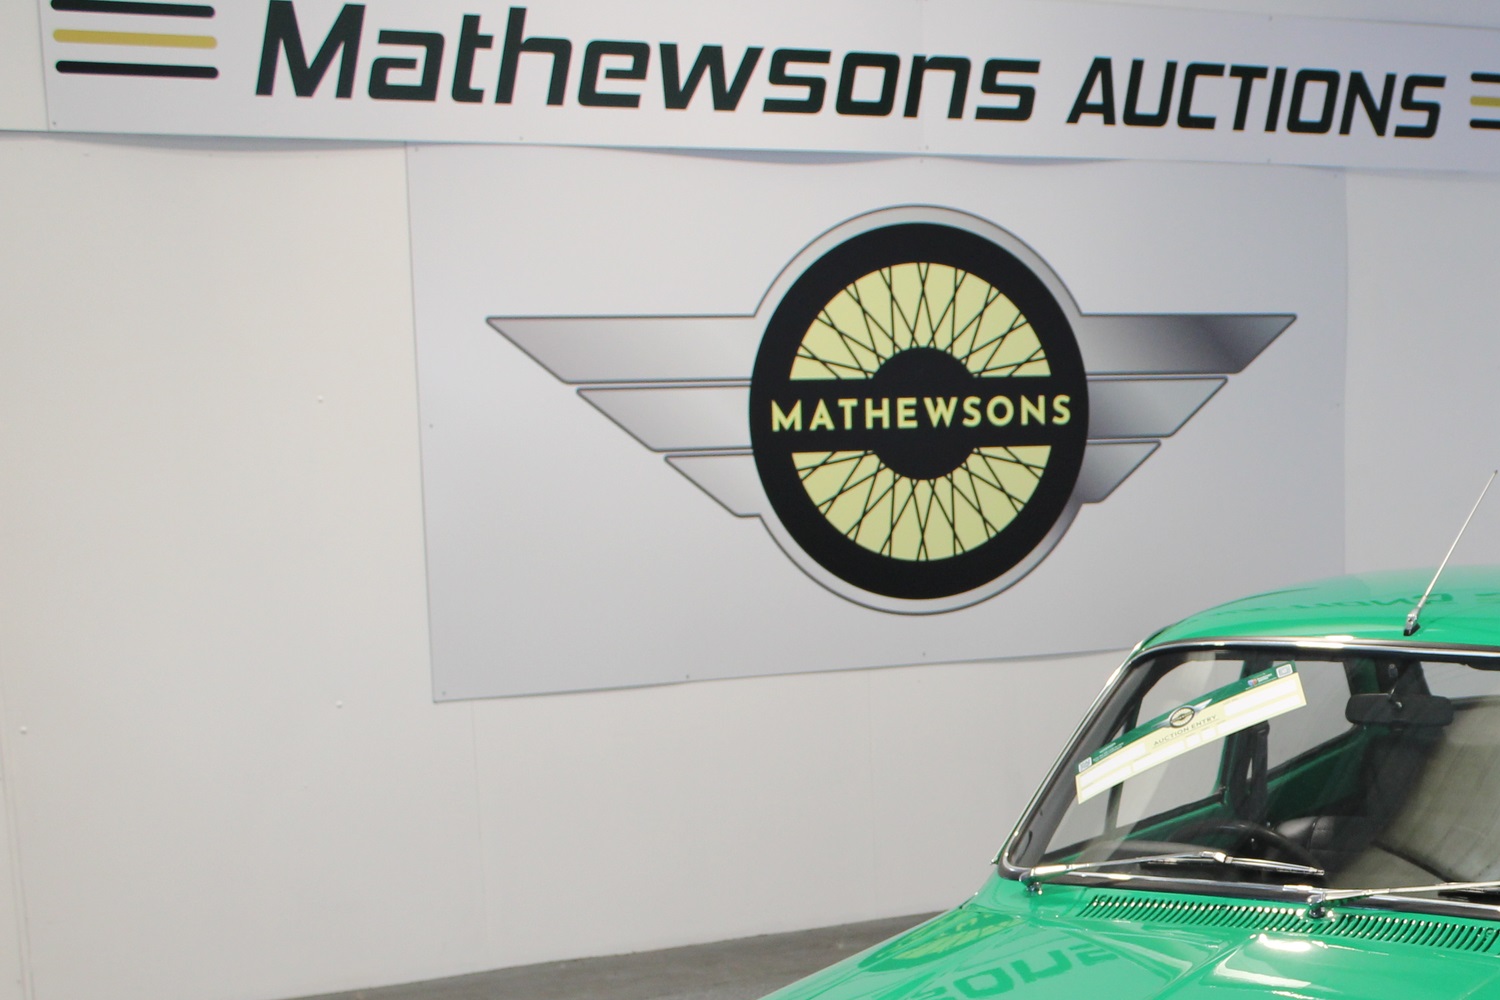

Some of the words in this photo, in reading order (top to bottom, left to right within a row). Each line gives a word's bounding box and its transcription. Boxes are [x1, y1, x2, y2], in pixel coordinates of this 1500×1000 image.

[255, 0, 1041, 122] Mathewsons
[1066, 56, 1447, 139] AUCTIONS
[771, 394, 1071, 432] MATHEWSONS
[1154, 726, 1190, 746] AUCTION
[1191, 714, 1217, 729] ENTRY
